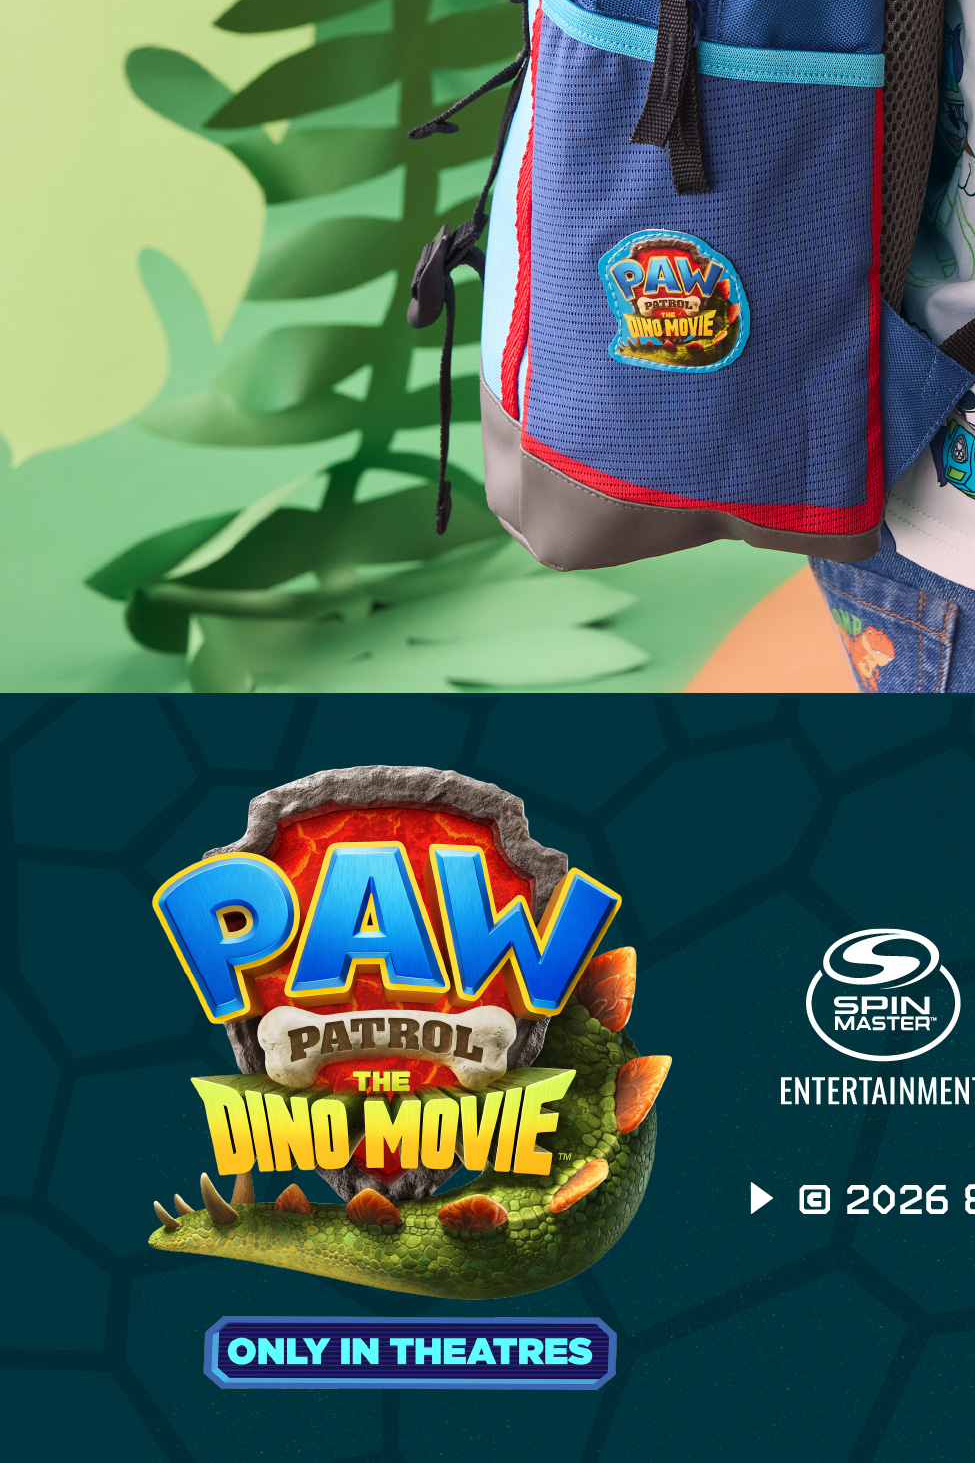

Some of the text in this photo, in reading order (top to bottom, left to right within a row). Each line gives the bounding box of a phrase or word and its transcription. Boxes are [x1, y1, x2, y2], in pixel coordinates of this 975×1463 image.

[609, 255, 724, 301] PAW
[645, 299, 693, 310] PATROL
[626, 310, 716, 339] DINO MOVIE
